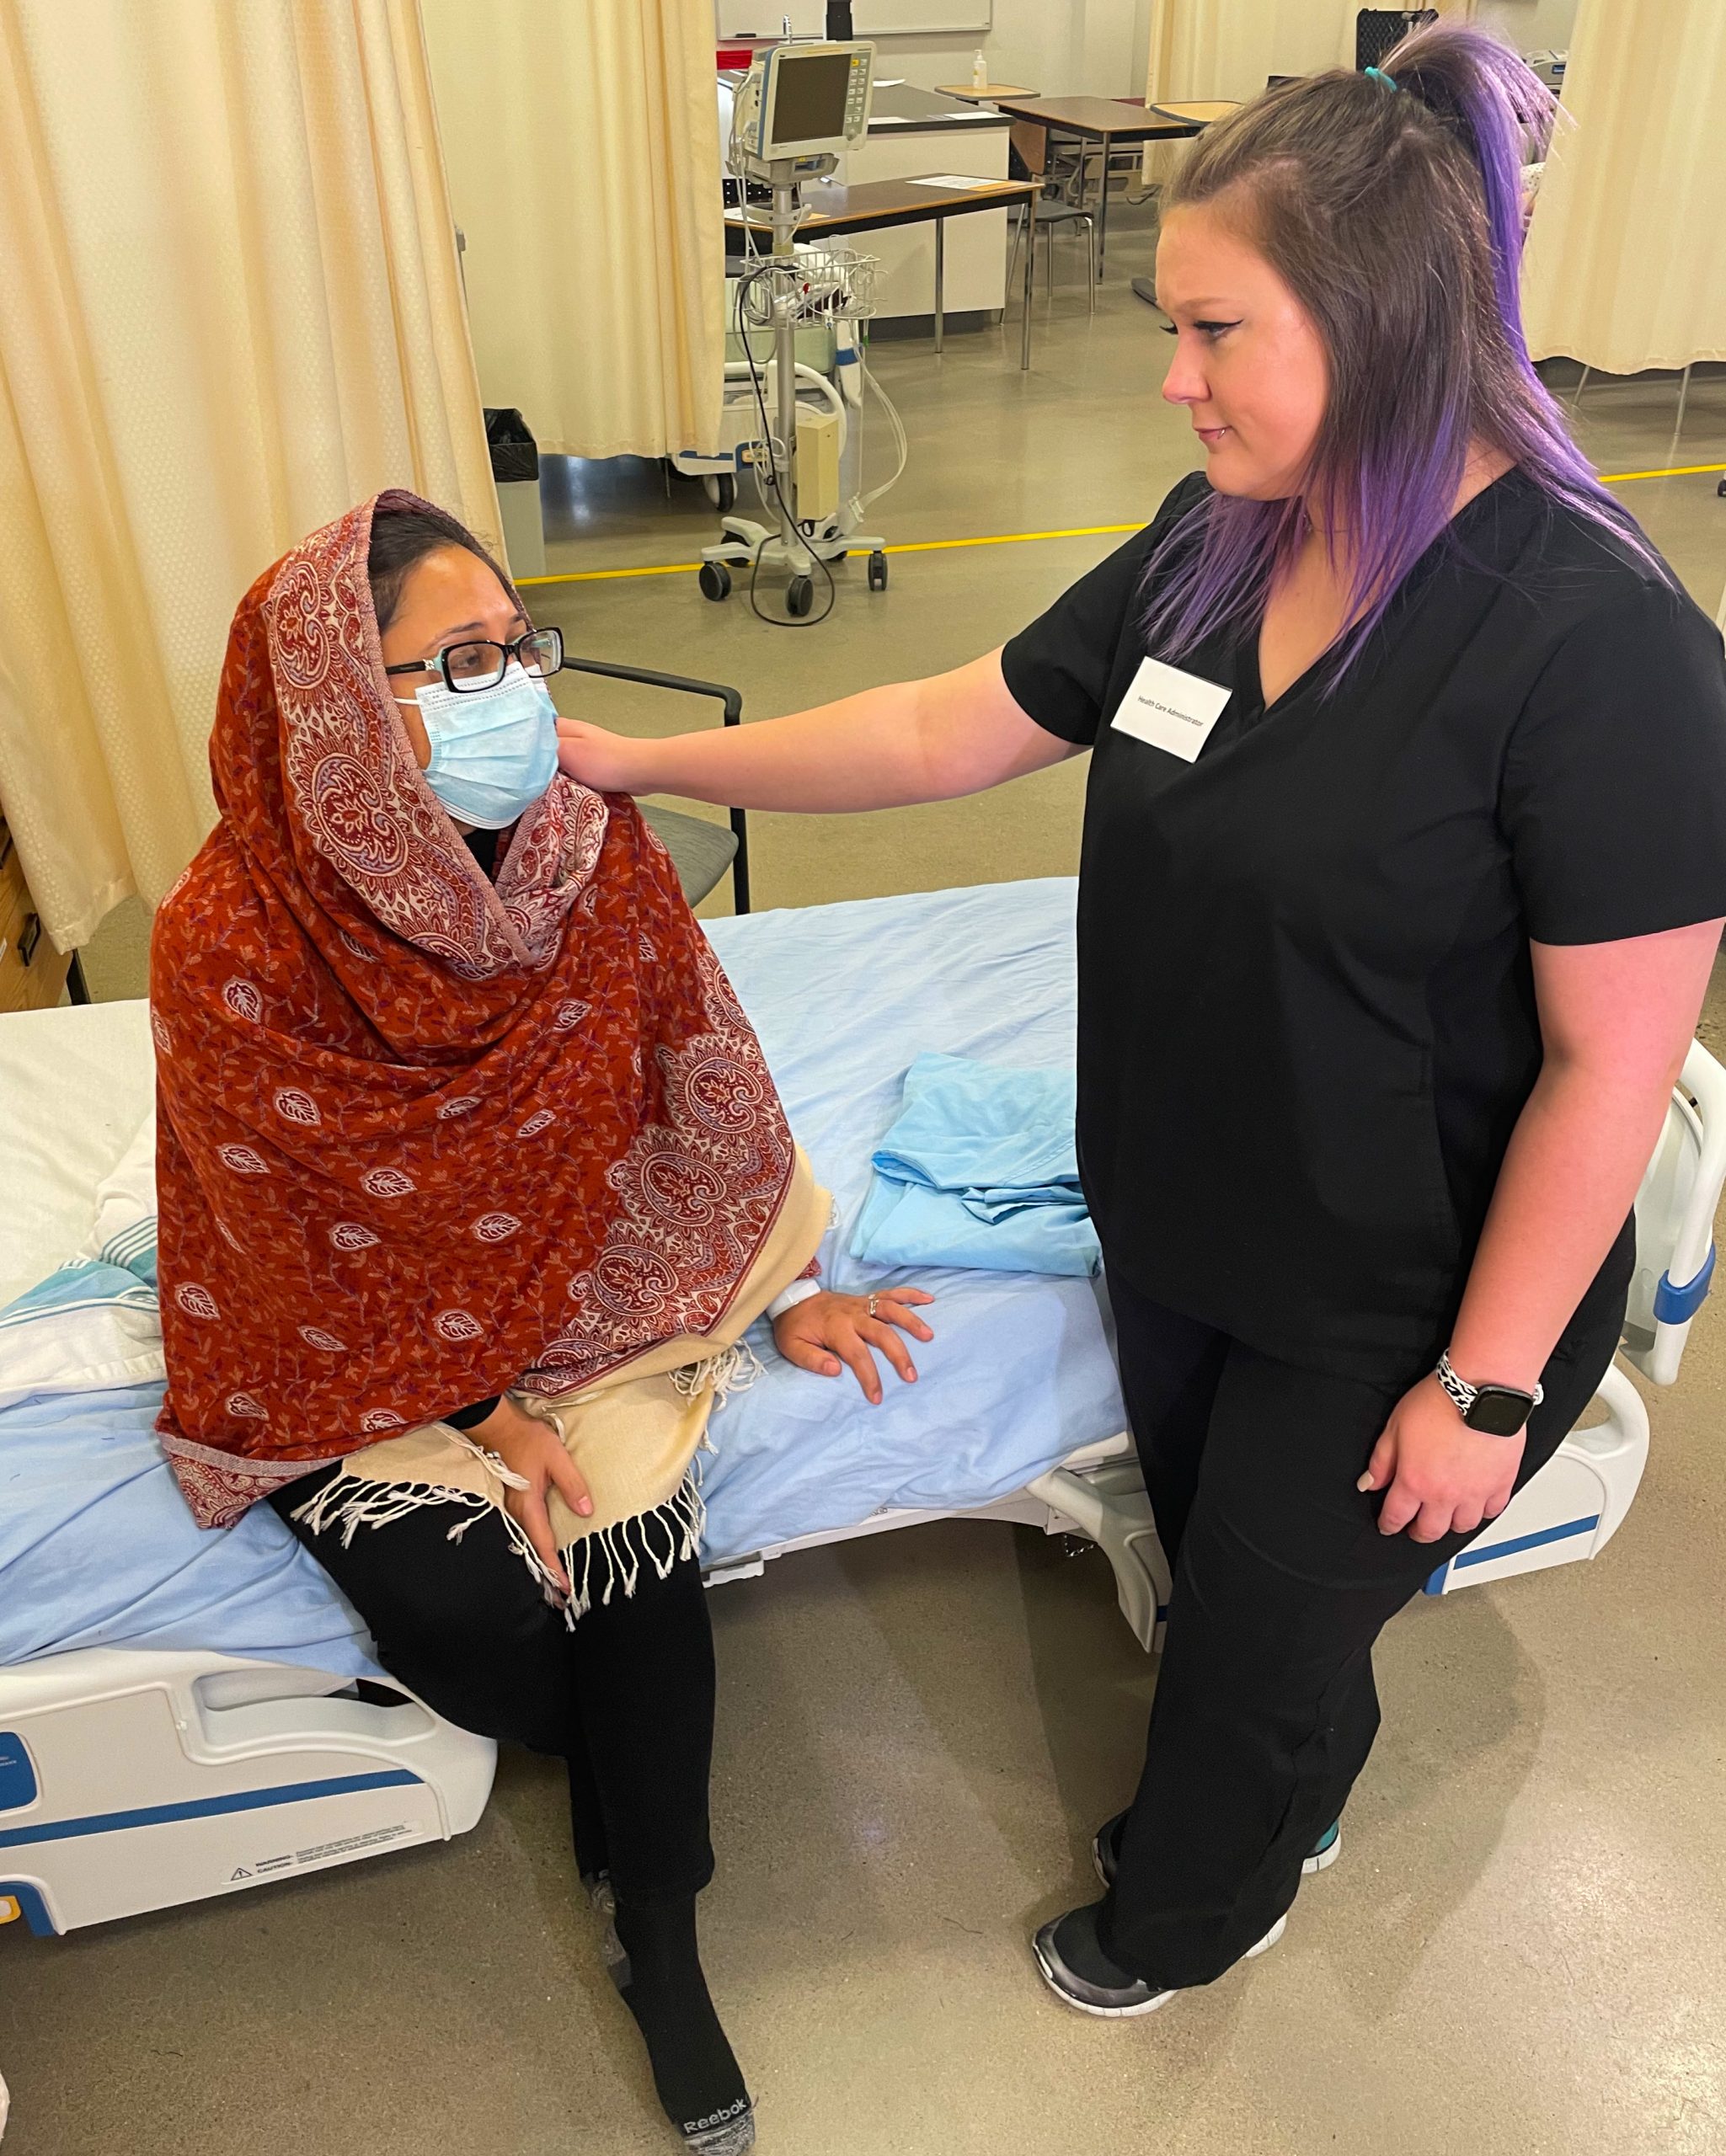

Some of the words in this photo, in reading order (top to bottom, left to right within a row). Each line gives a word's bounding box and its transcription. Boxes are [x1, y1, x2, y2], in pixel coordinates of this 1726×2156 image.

[1137, 695, 1155, 707] Health
[1155, 702, 1167, 712] Care
[1167, 707, 1204, 727] Administrator
[683, 2099, 747, 2134] Reebok
